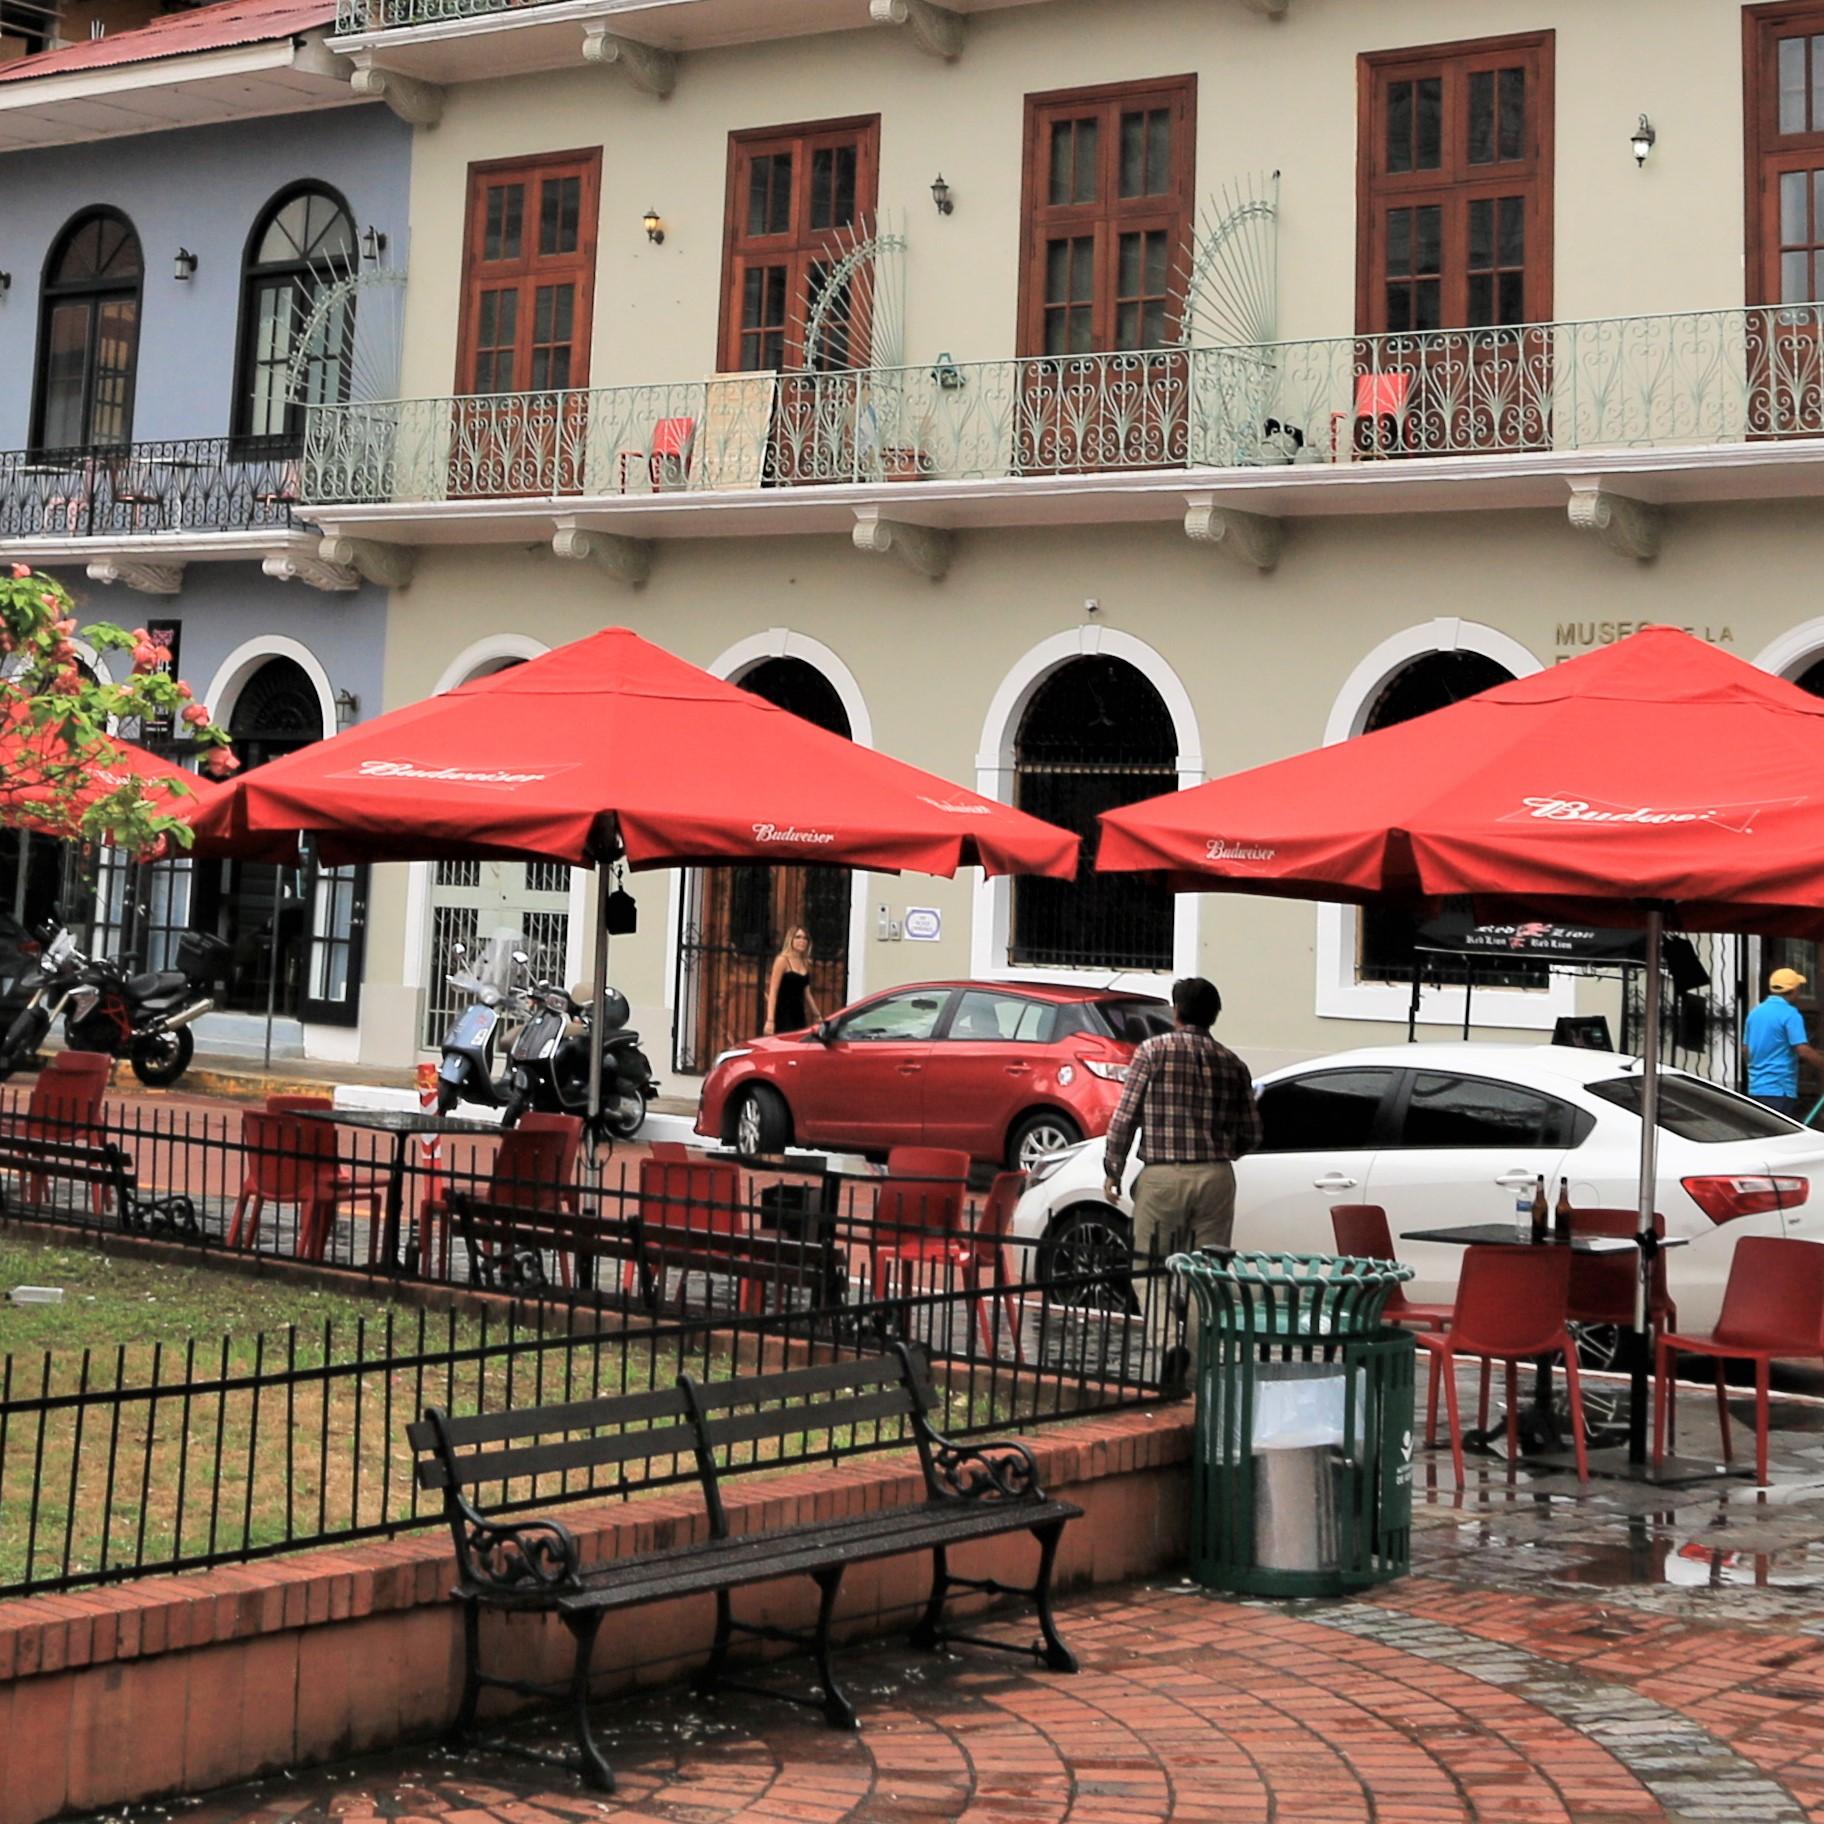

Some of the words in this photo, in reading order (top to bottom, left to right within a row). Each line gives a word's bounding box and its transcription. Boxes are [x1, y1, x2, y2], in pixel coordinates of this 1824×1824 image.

[1706, 627, 1733, 642] LA
[359, 760, 545, 783] Budweiser
[752, 823, 834, 843] Budweiser
[1206, 839, 1275, 860] Budweiser
